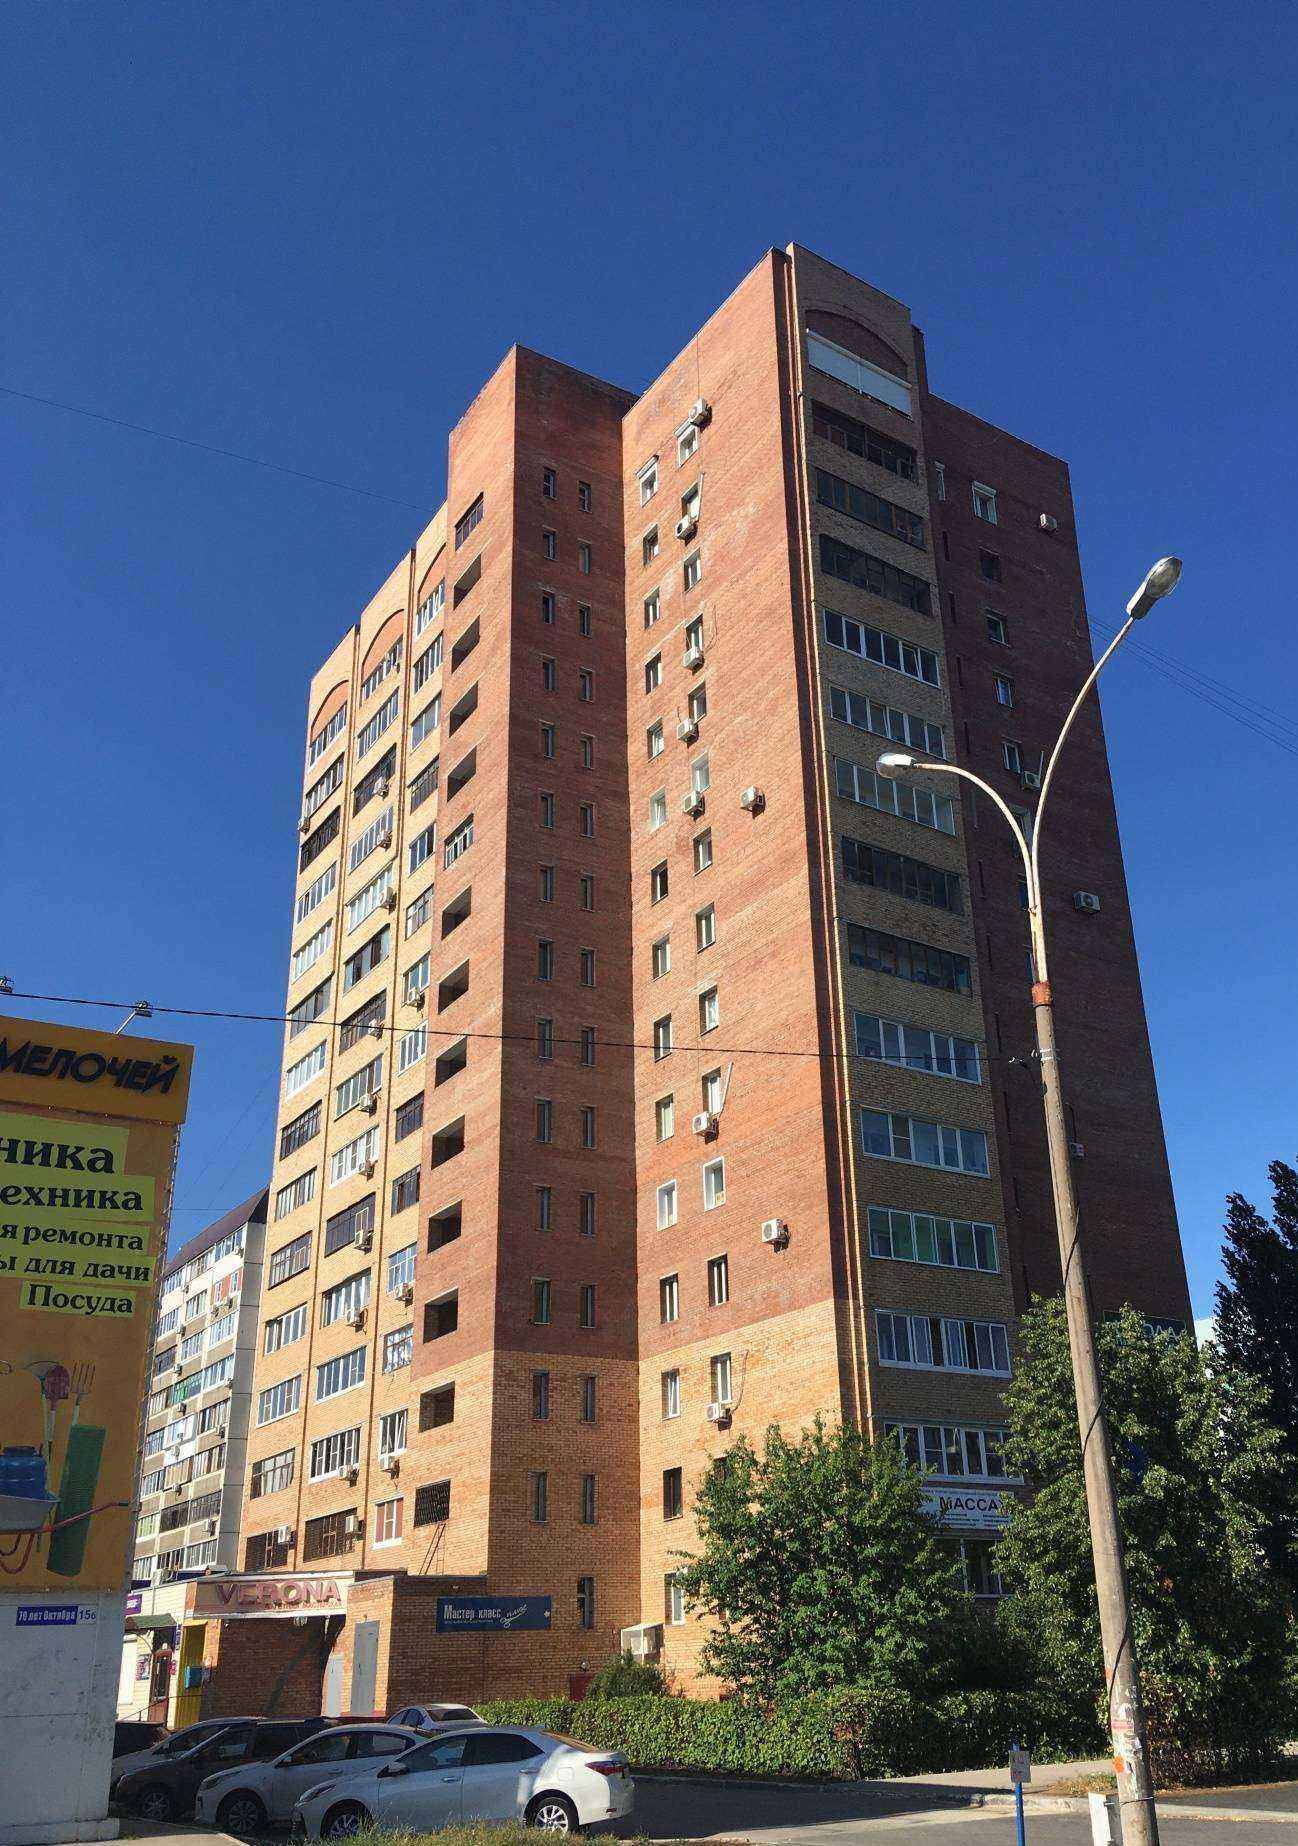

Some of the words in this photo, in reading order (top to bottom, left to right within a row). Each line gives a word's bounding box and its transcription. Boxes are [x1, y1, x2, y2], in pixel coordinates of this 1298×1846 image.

[0, 1036, 180, 1095] МЕЛОЧЕЙ
[22, 1225, 144, 1251] ремонта
[24, 1257, 76, 1275] для
[82, 1261, 150, 1282] дачи
[27, 1283, 134, 1316] Посуда
[940, 1496, 1004, 1512] МАССА
[215, 1580, 342, 1606] VERONA
[28, 1612, 43, 1621] лет
[43, 1610, 76, 1621] Октября
[443, 1604, 475, 1621] Мастер
[478, 1608, 501, 1619] класс
